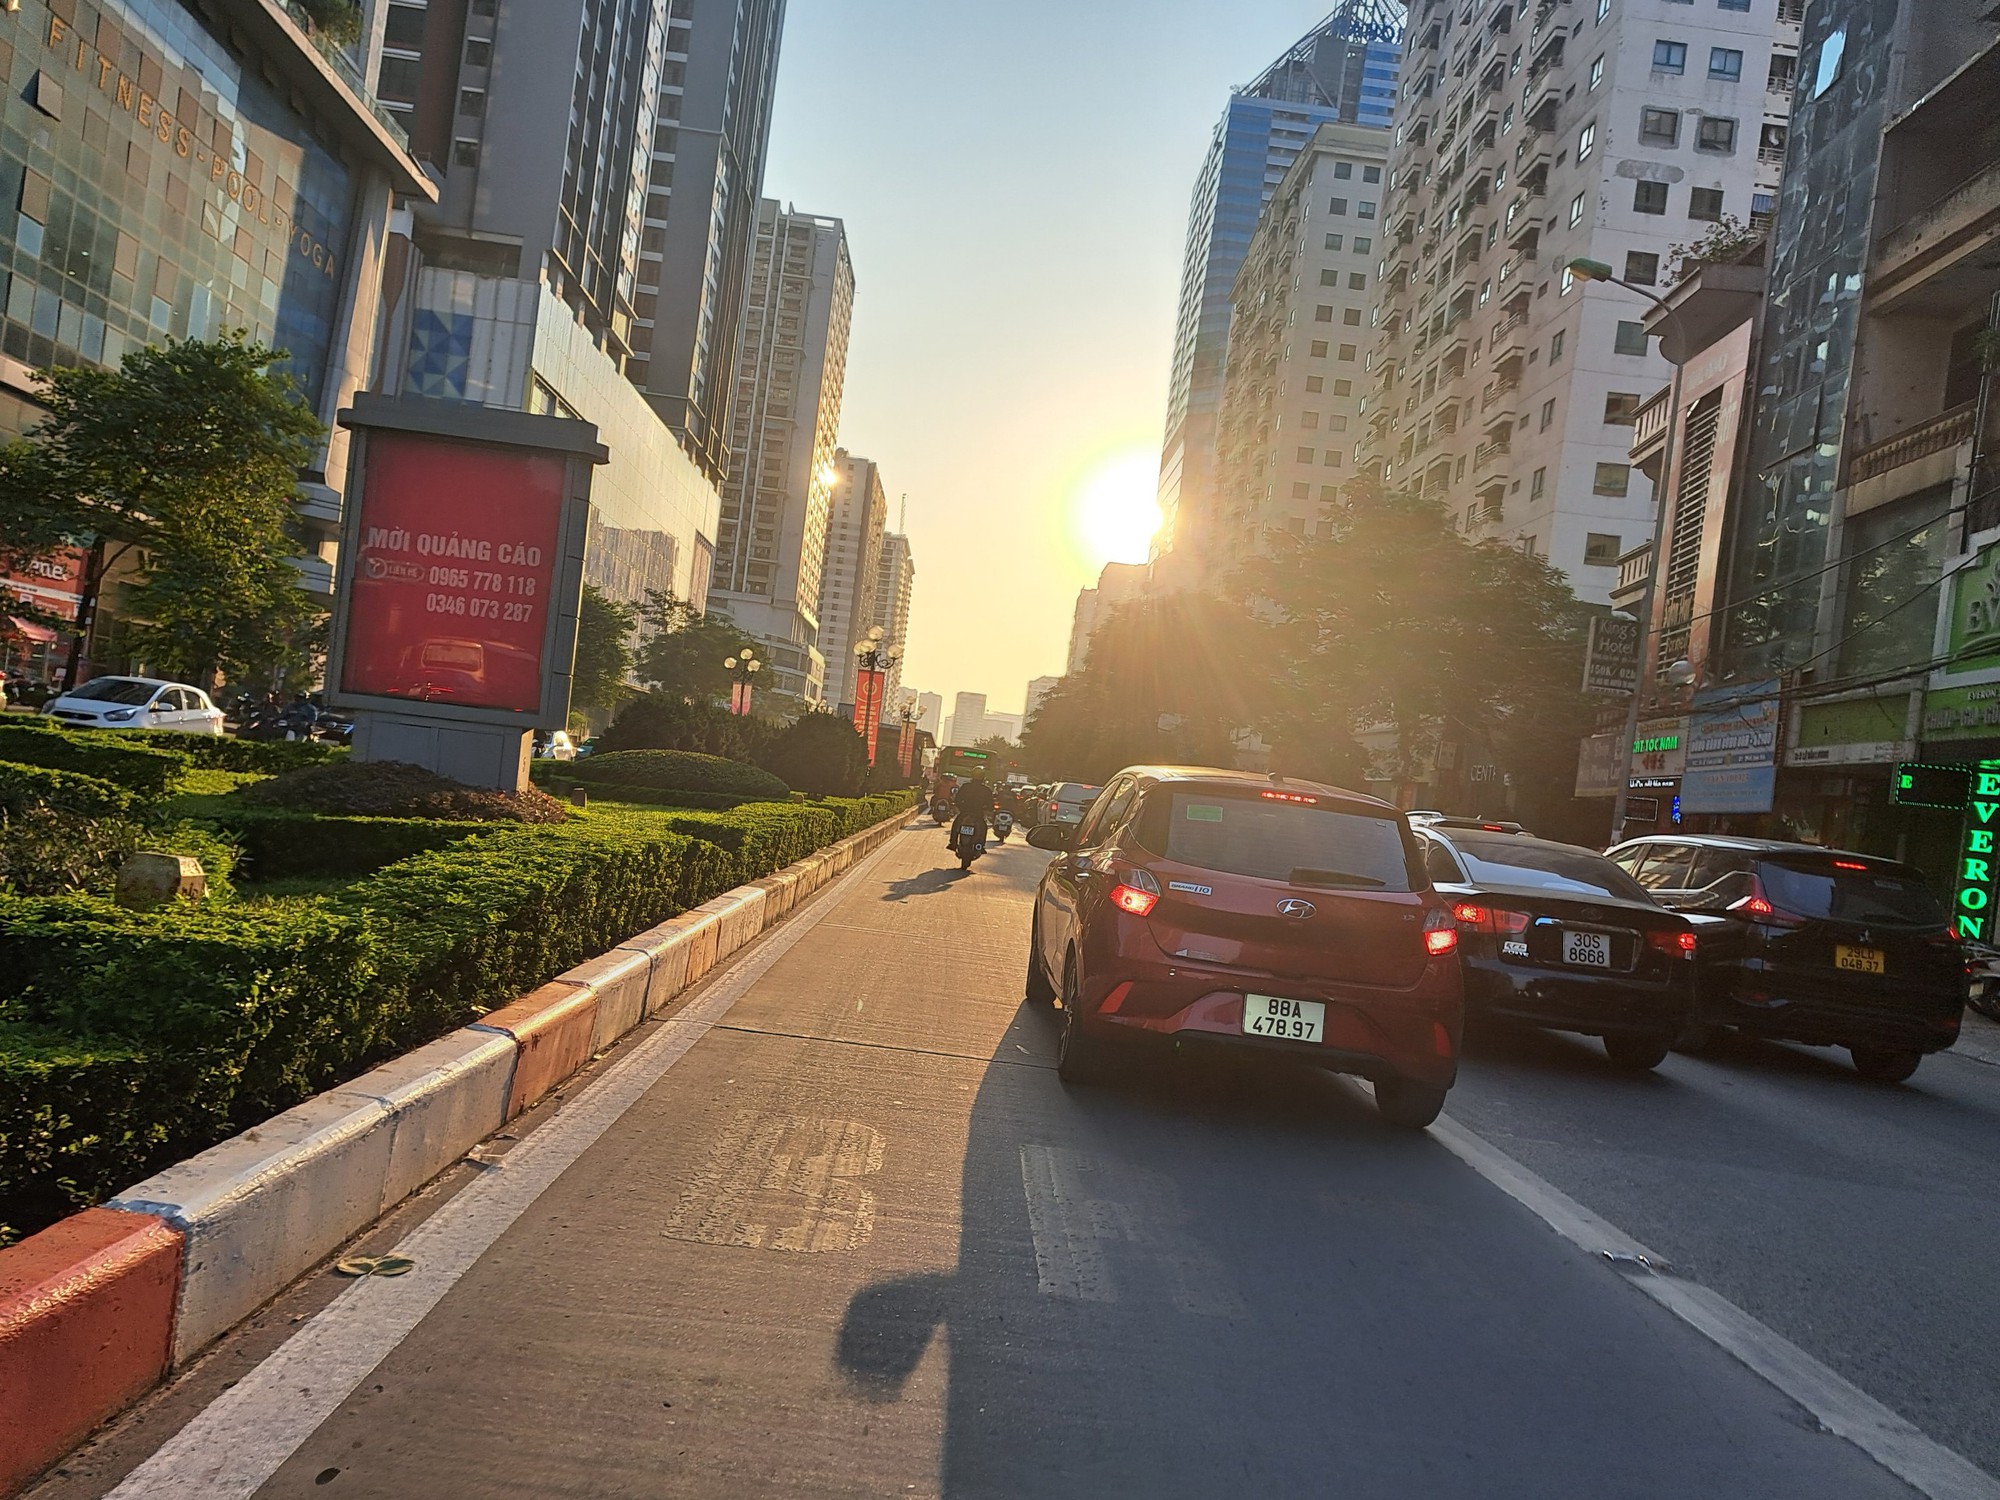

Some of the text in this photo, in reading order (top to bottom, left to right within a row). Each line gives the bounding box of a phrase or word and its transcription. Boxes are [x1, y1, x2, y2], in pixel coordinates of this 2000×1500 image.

[368, 525, 542, 566] MỜI QUẢNG CÁO
[428, 565, 536, 596] 0965 778 118
[425, 592, 533, 623] 0346 073 287
[1600, 620, 1637, 640] King's
[1599, 636, 1634, 654] Hotel
[1573, 933, 1601, 949] 30S
[1569, 947, 1605, 965] 8668
[1268, 998, 1302, 1019] 88A
[1252, 1016, 1316, 1040] 478.97
